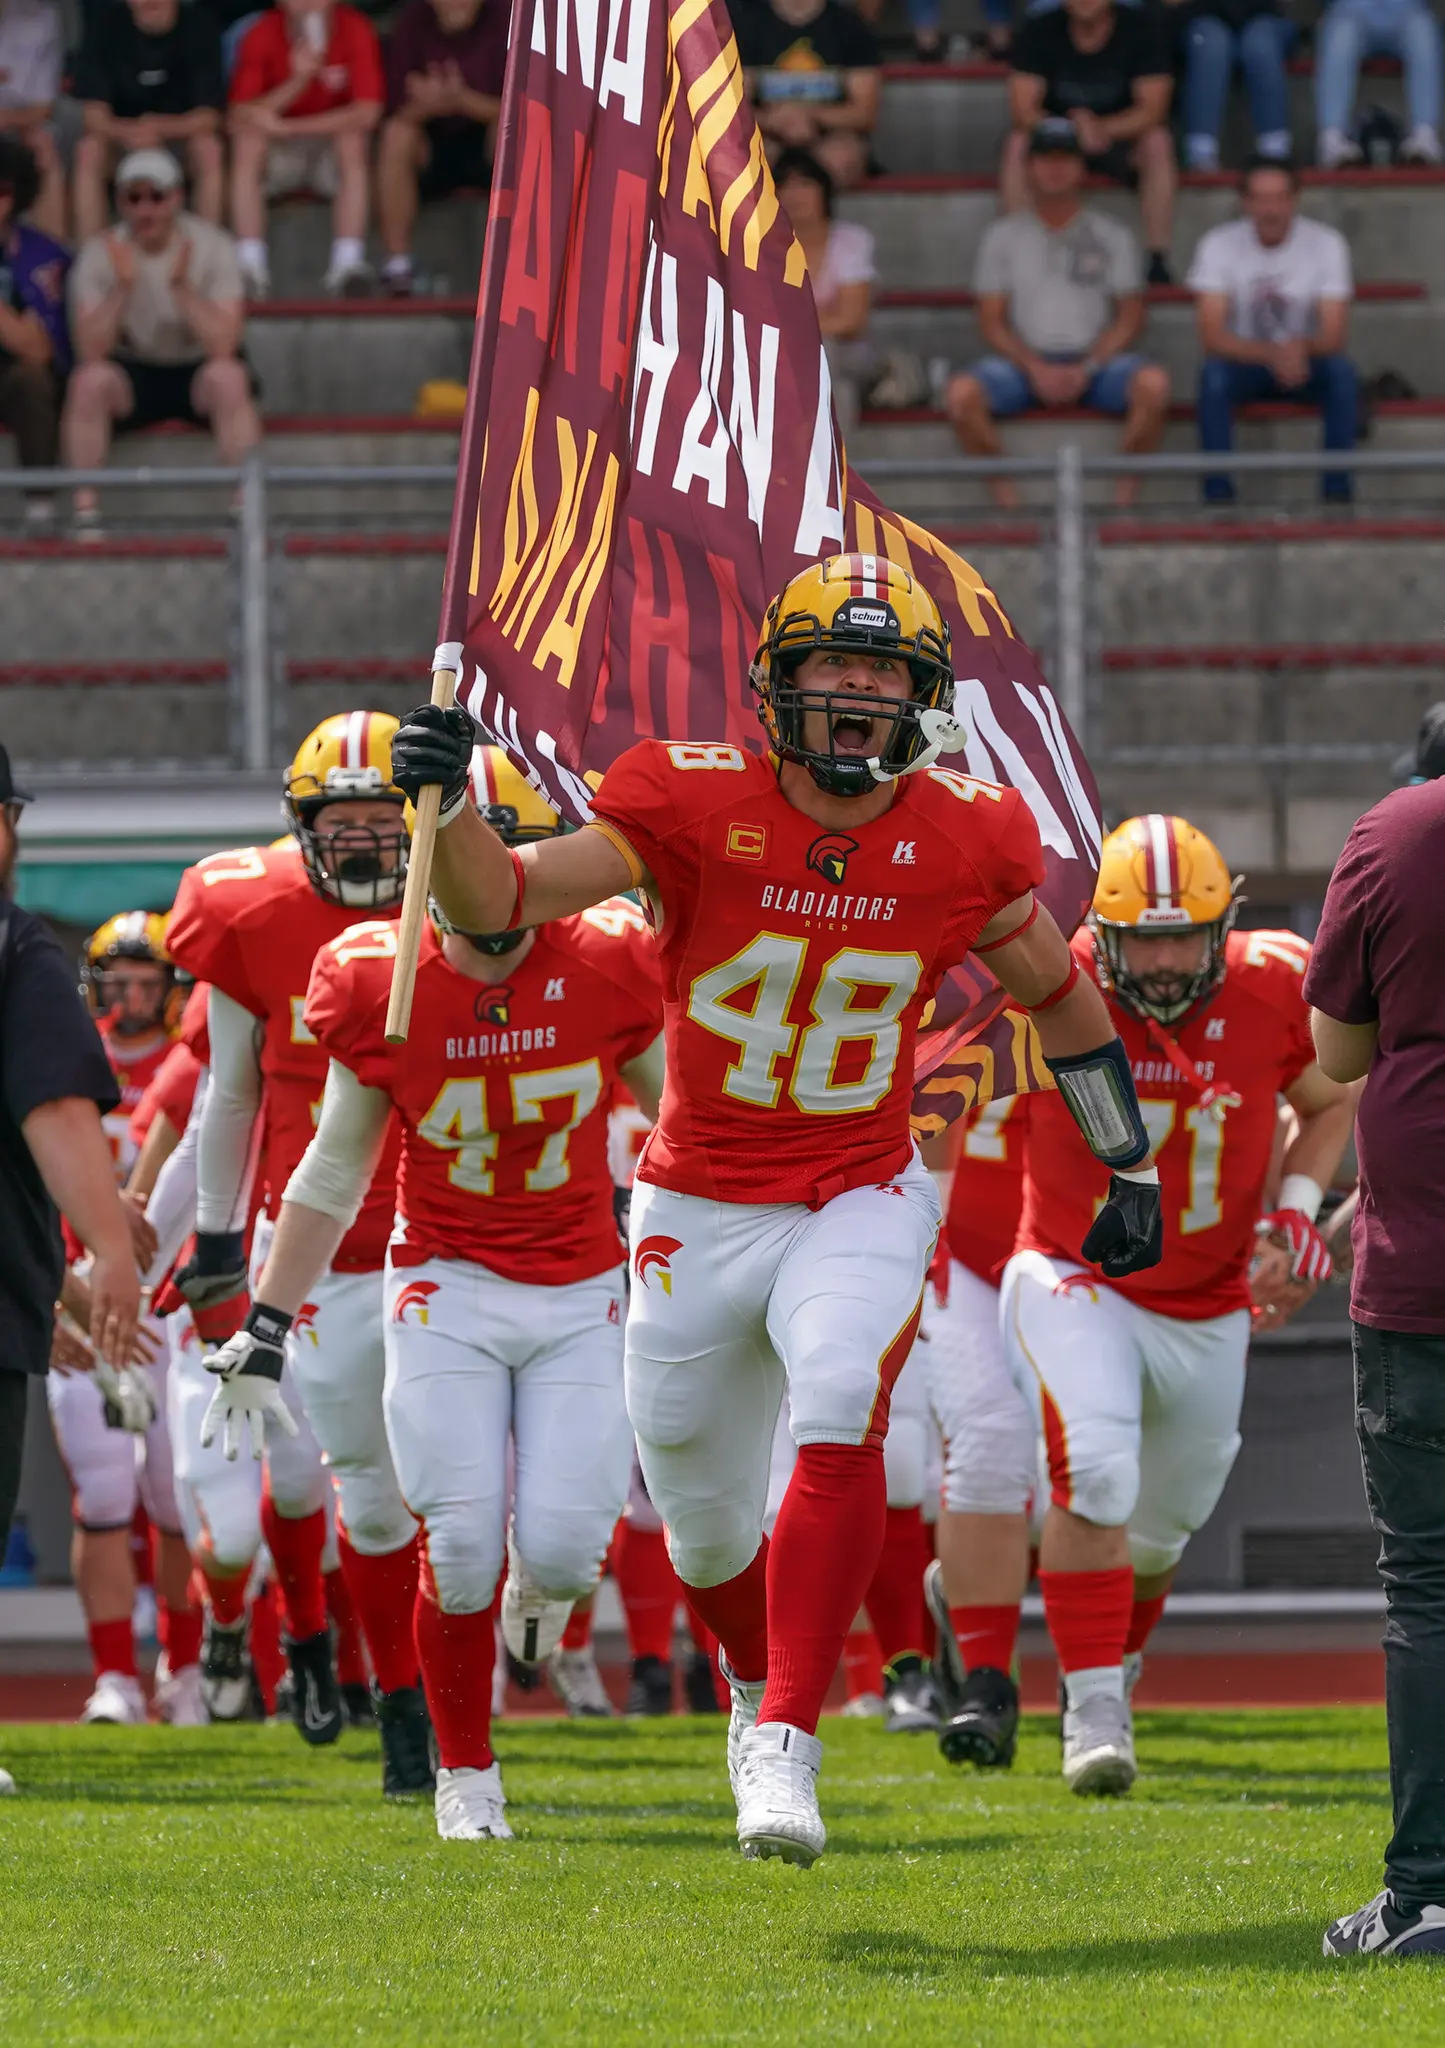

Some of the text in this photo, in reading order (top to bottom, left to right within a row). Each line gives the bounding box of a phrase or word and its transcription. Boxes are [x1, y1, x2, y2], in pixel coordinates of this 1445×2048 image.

[851, 611, 886, 623] schutt
[730, 830, 763, 853] C
[761, 885, 897, 921] GLADIATORS
[804, 920, 848, 931] RIED
[687, 931, 924, 1114] 48
[446, 1026, 556, 1059] GLADIATORS
[416, 1057, 602, 1195] 47
